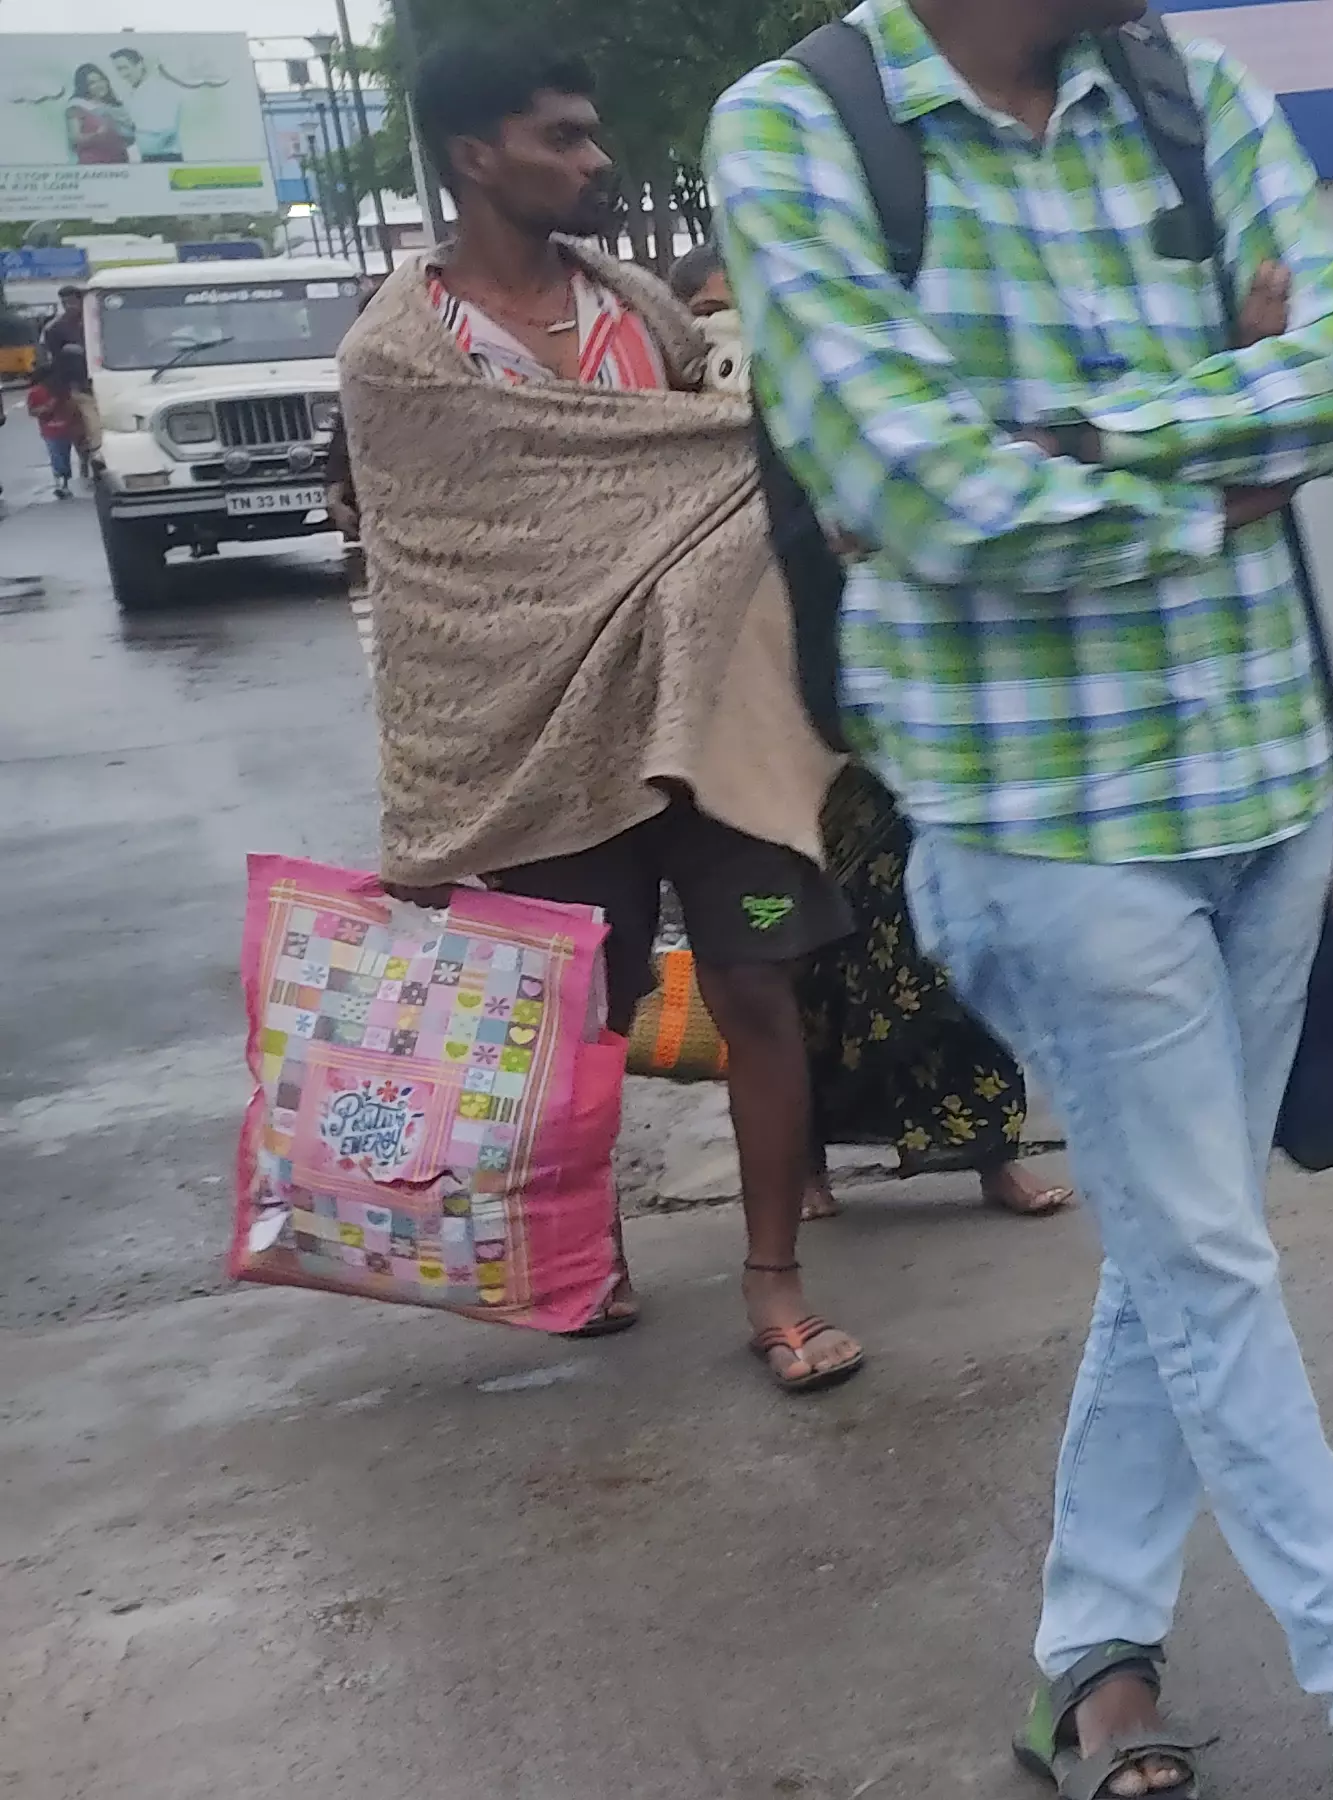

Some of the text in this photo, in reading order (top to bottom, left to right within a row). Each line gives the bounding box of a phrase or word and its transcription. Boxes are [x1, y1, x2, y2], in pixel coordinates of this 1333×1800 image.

[230, 496, 252, 510] TN
[256, 495, 275, 508] 33
[279, 493, 291, 507] N
